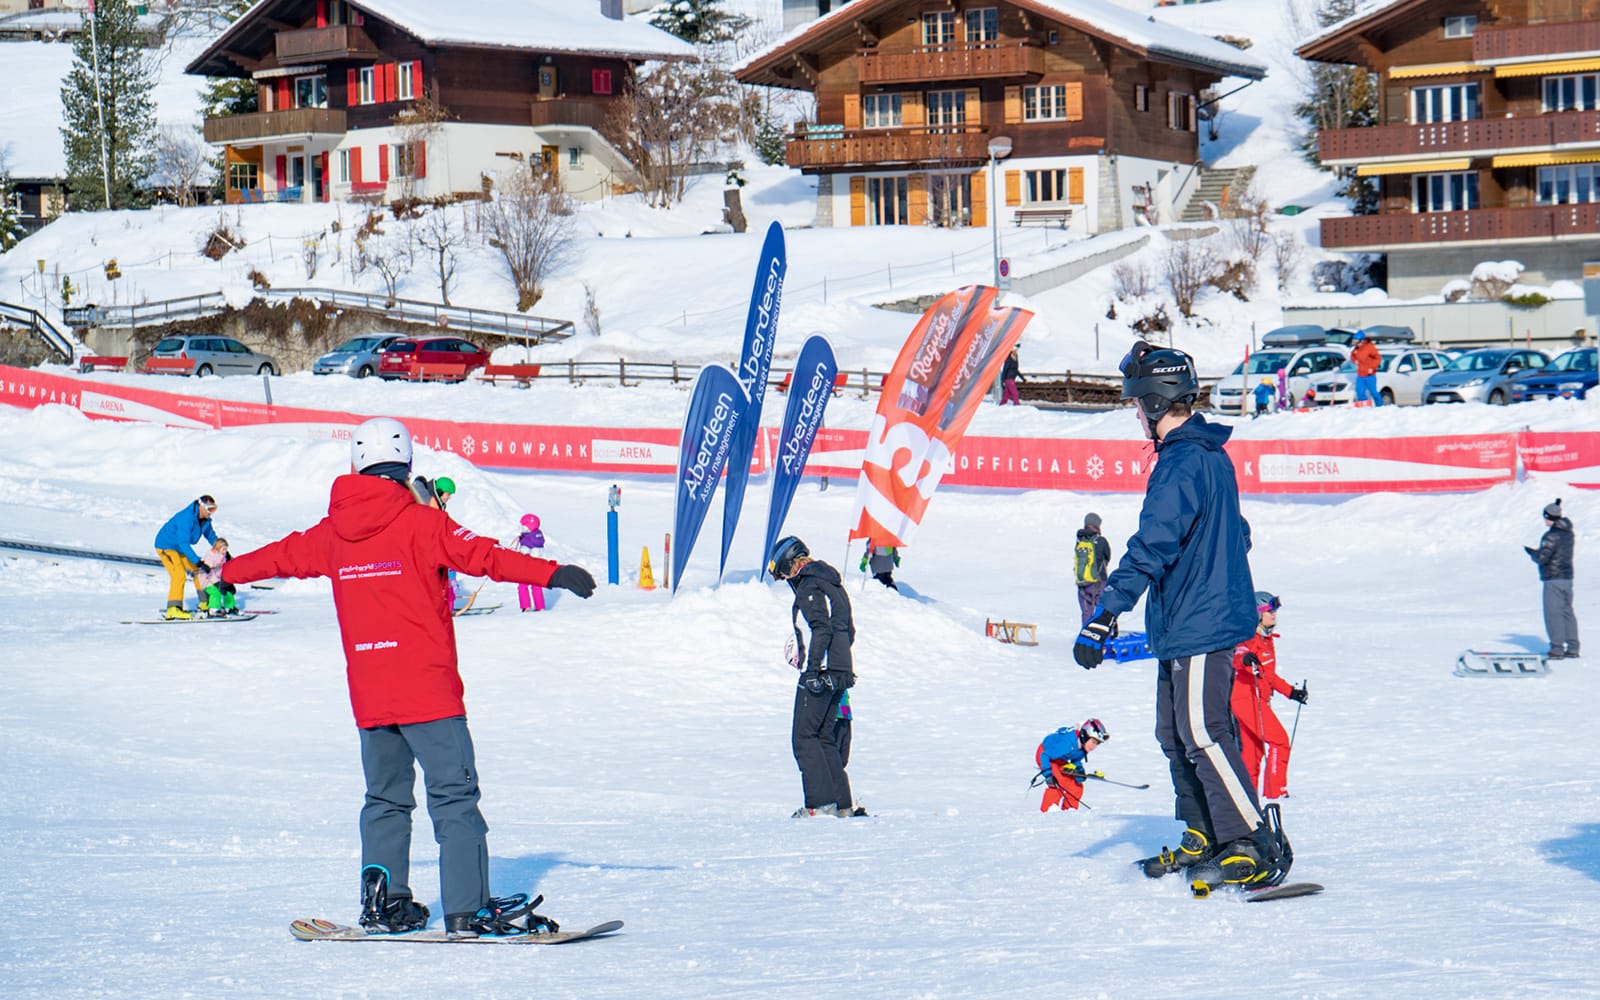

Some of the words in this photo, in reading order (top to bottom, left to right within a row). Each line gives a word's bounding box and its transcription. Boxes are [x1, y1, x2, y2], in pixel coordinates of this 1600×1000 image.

[742, 257, 780, 404] Aberdeen
[756, 366, 768, 404] Asset
[765, 277, 784, 365] management
[910, 312, 948, 382] Ragusa
[1152, 365, 1187, 373] SCOTT
[481, 441, 588, 458] SNOWPARK
[684, 392, 732, 501] Aberdeen
[700, 476, 716, 503] Asset
[713, 410, 740, 475] management
[782, 362, 828, 475] Aberdeen
[794, 440, 808, 475] Asset
[804, 379, 831, 443] management
[960, 456, 1075, 473] OFFICIAL
